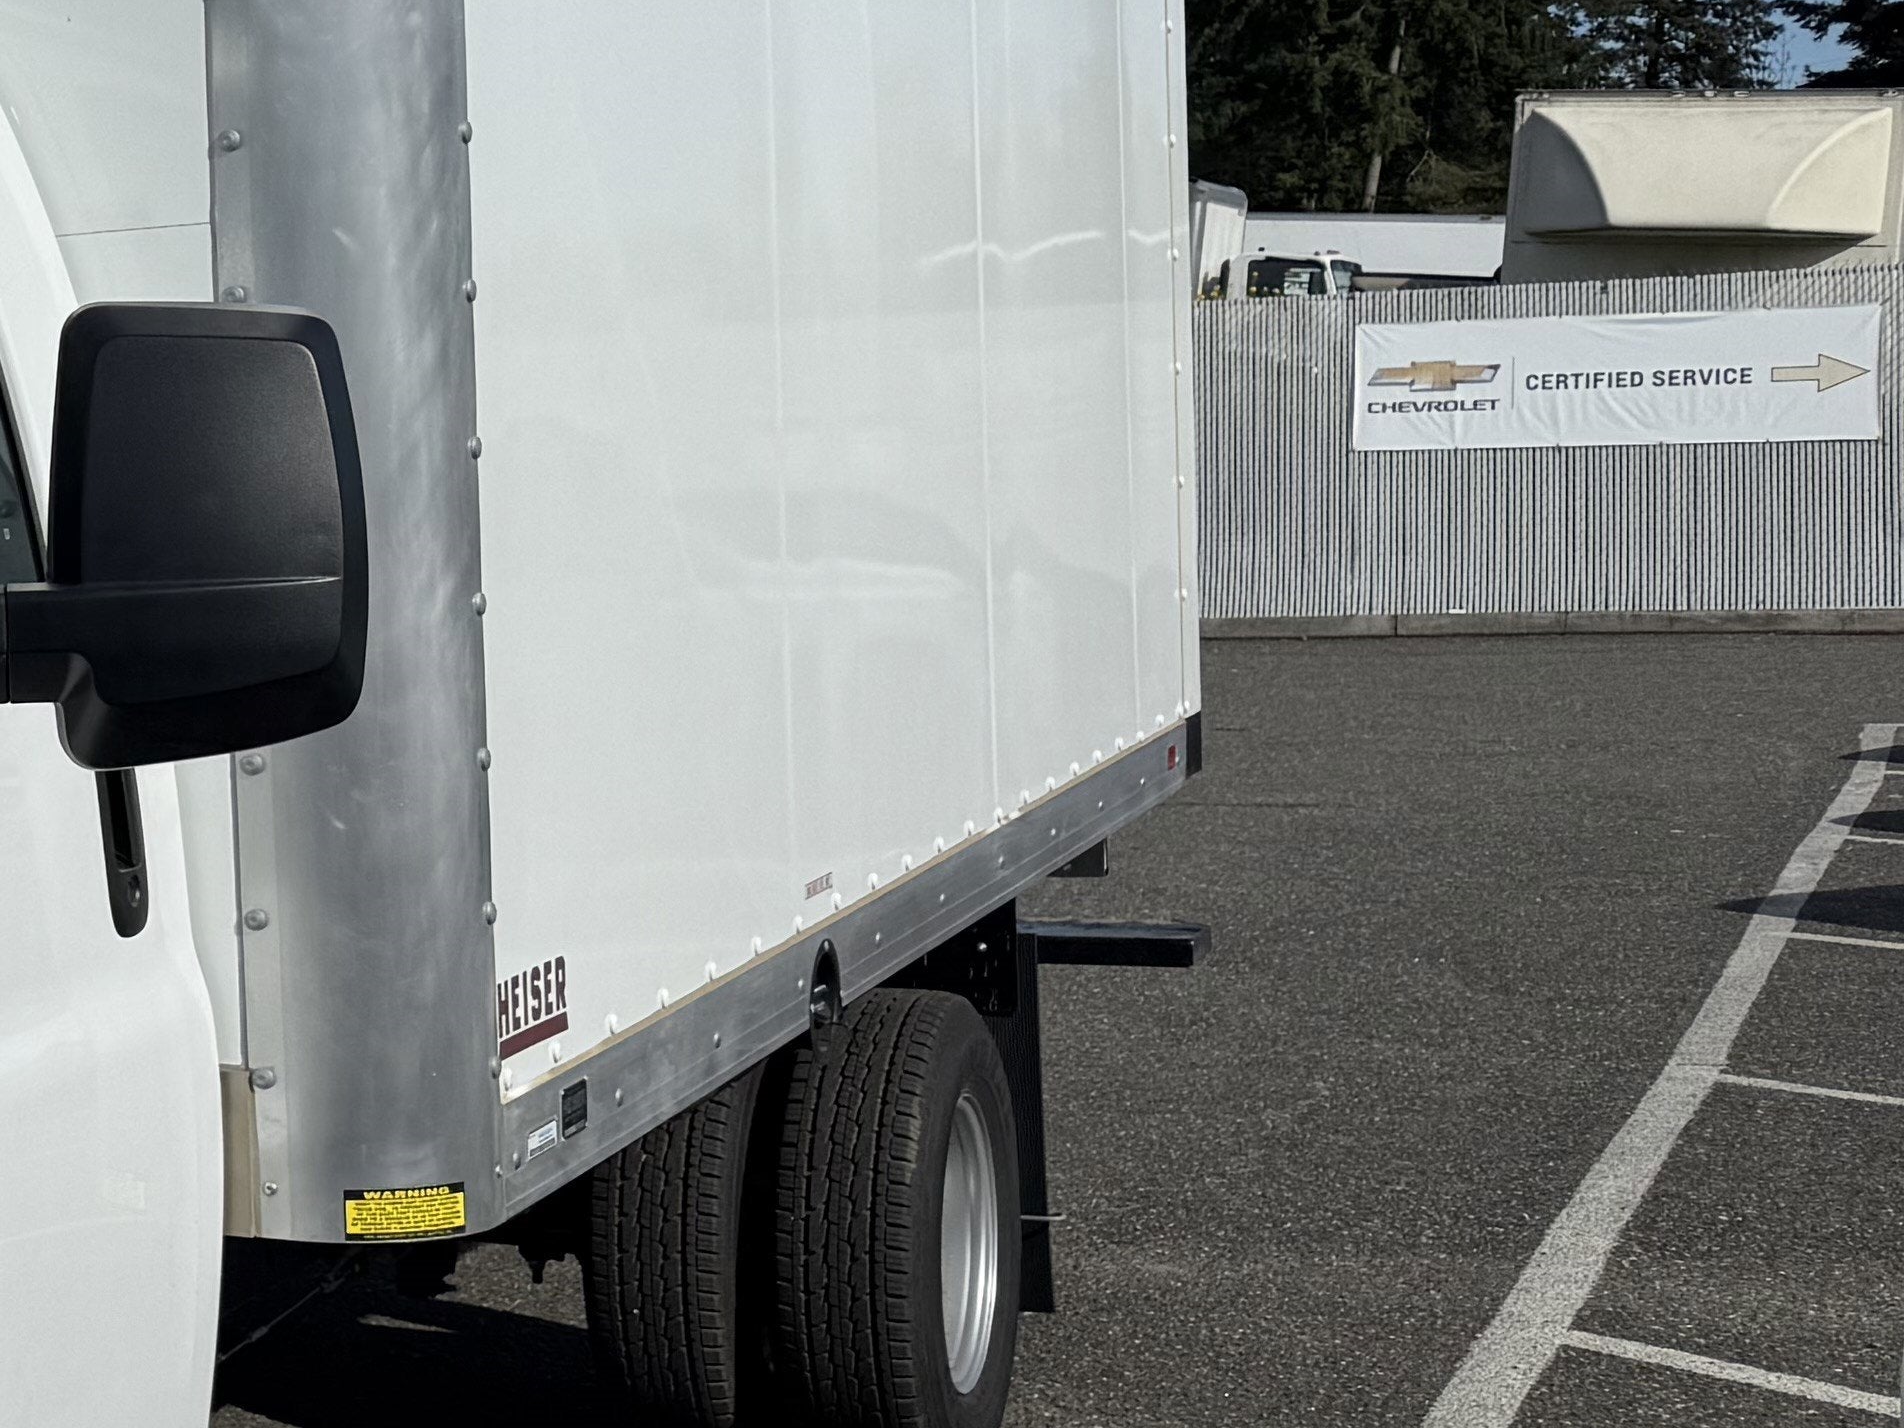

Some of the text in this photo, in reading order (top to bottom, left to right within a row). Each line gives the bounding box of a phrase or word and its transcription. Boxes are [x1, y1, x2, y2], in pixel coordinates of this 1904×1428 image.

[1524, 366, 1754, 392] CERTIFIED SERVICE
[1366, 397, 1501, 414] CHEVROLET
[497, 955, 567, 1039] HEISER
[363, 1186, 450, 1200] WARNING
